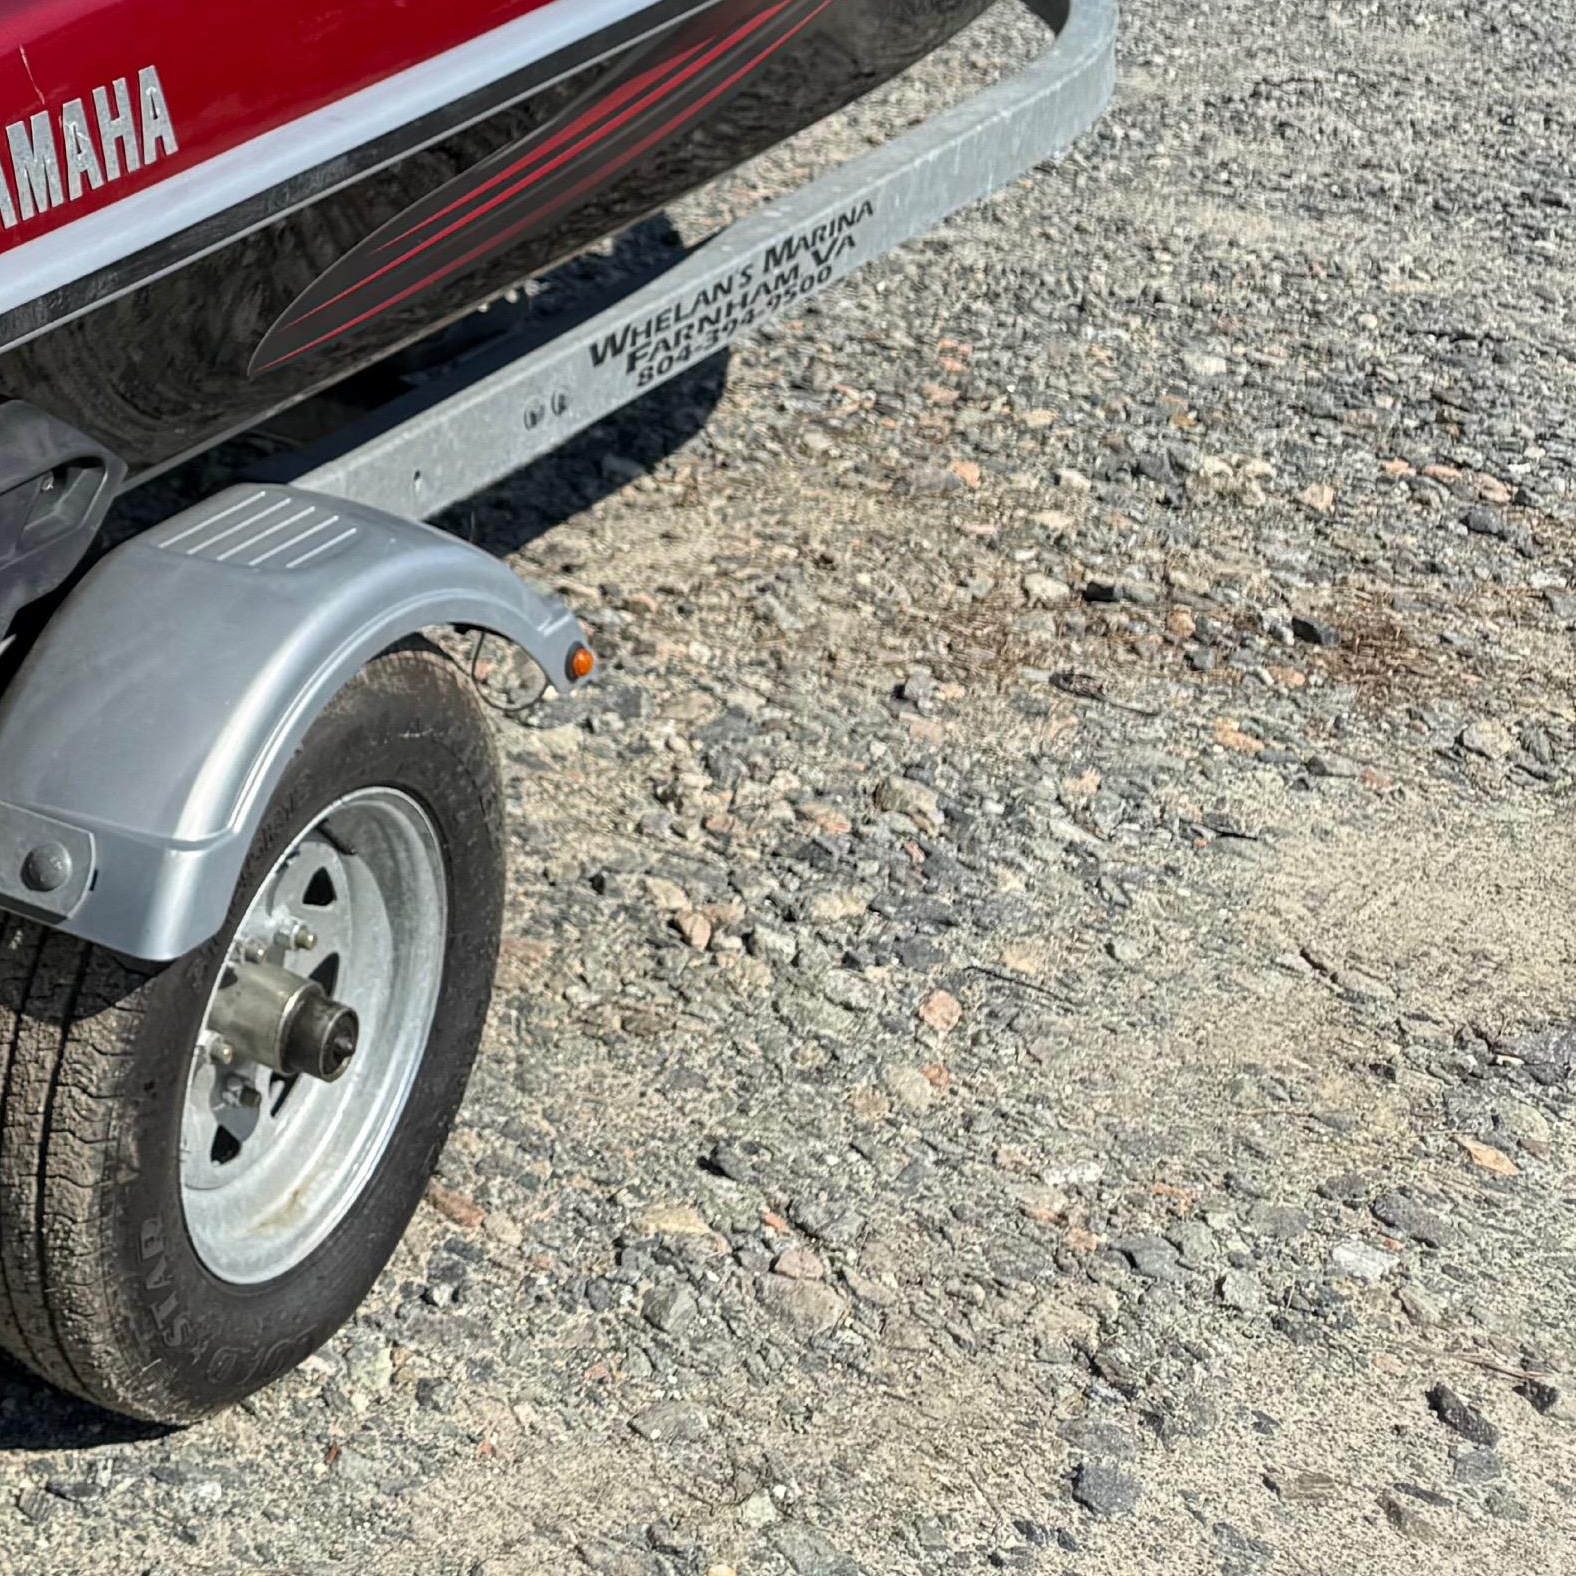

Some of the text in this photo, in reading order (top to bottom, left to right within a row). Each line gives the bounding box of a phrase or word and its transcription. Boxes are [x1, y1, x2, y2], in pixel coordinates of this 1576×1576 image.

[588, 200, 874, 368] WHELAN'S MARINA
[811, 234, 856, 267] VA
[637, 265, 833, 387] 804-394-9500
